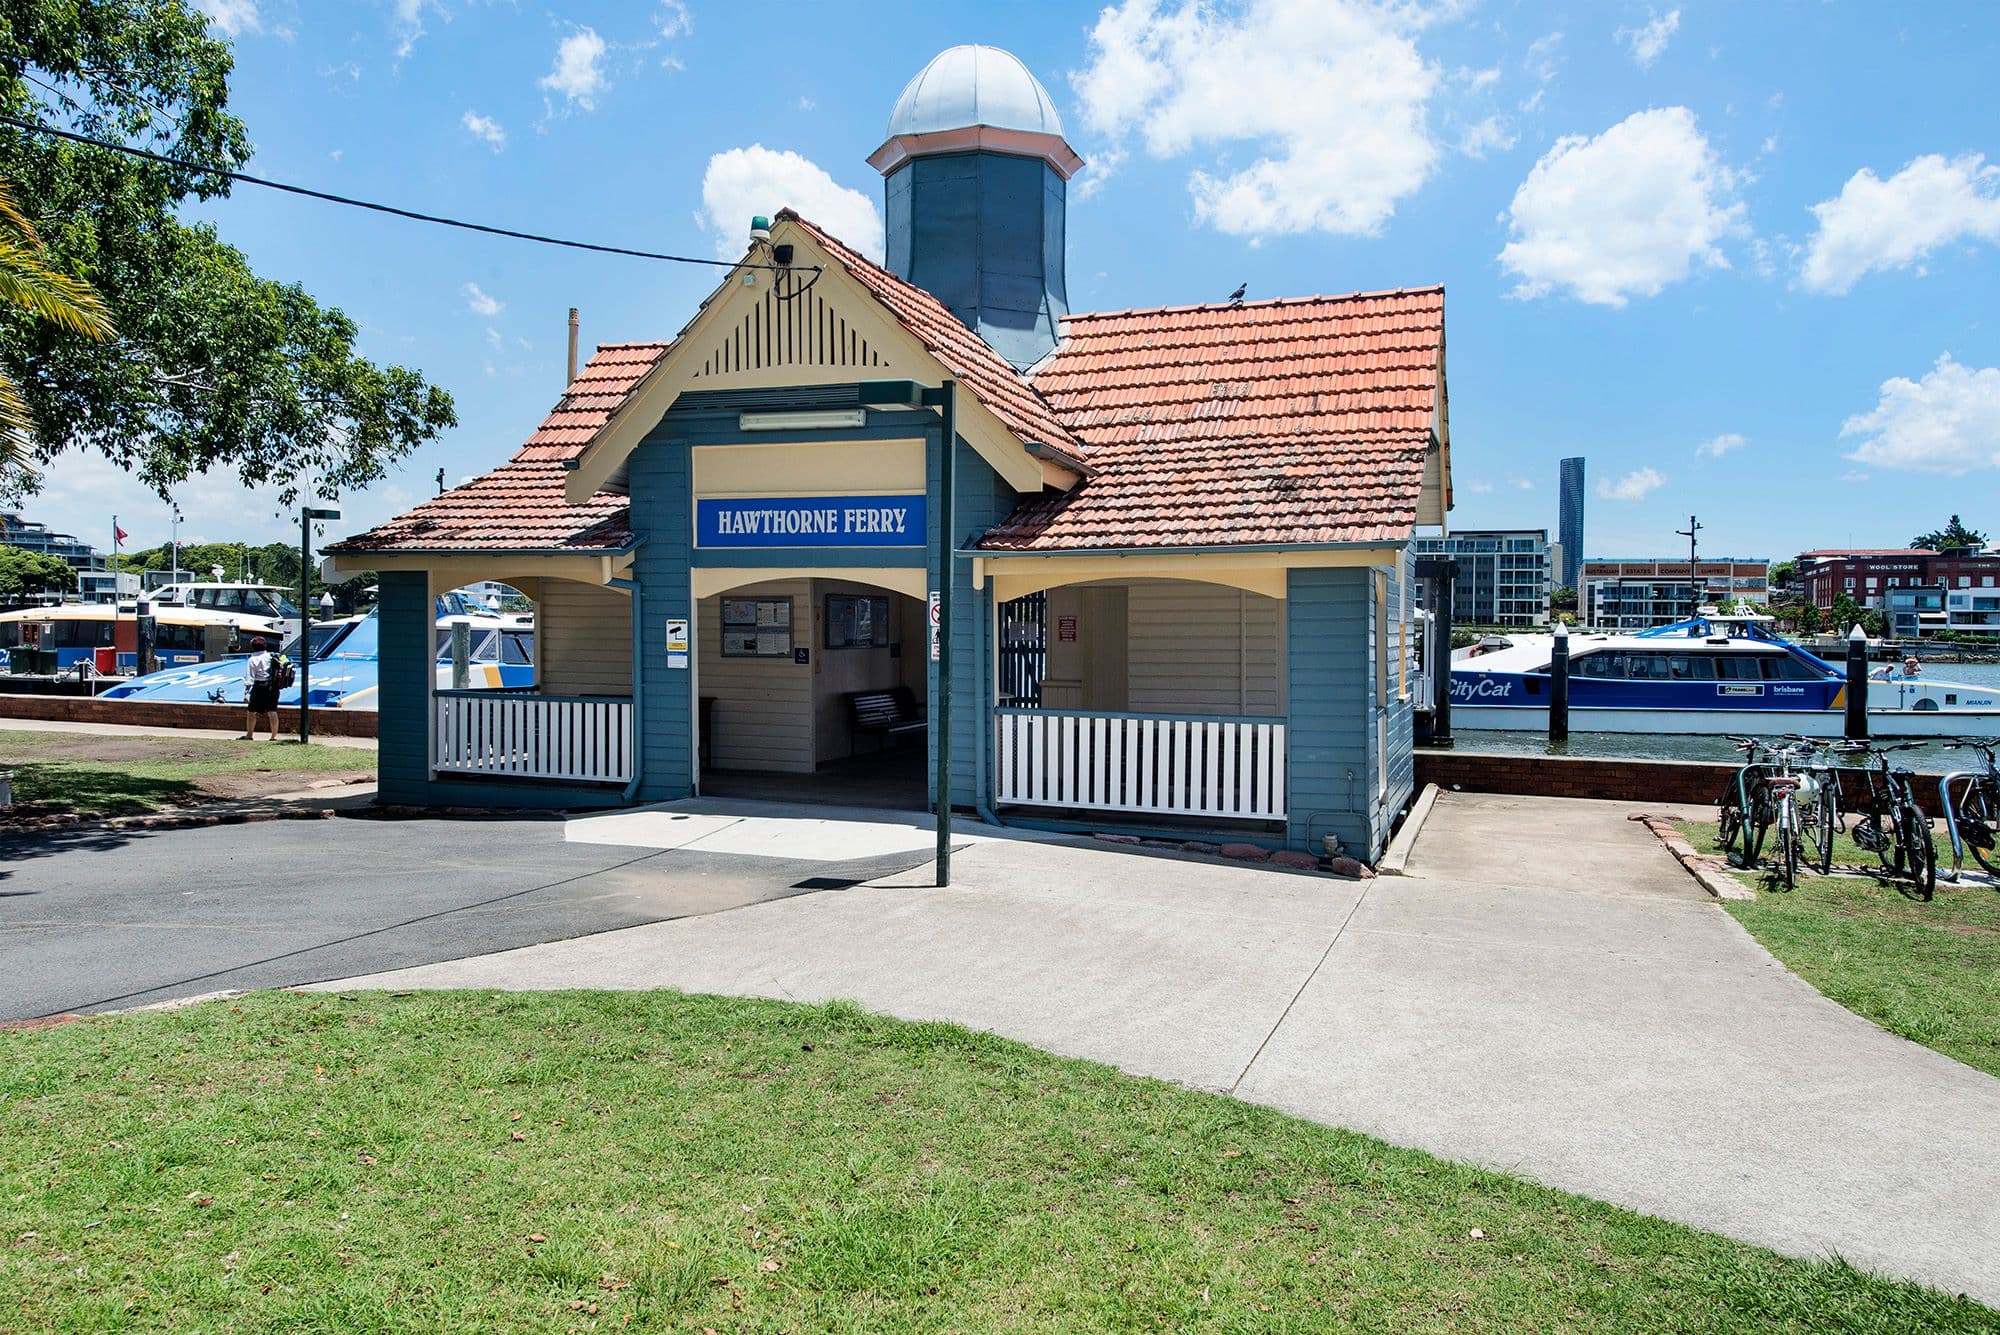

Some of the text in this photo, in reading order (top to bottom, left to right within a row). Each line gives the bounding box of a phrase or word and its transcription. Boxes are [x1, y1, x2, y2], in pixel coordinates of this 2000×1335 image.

[718, 508, 907, 534] HAWTHORNE FERRY
[1773, 685, 1804, 693] brisbane
